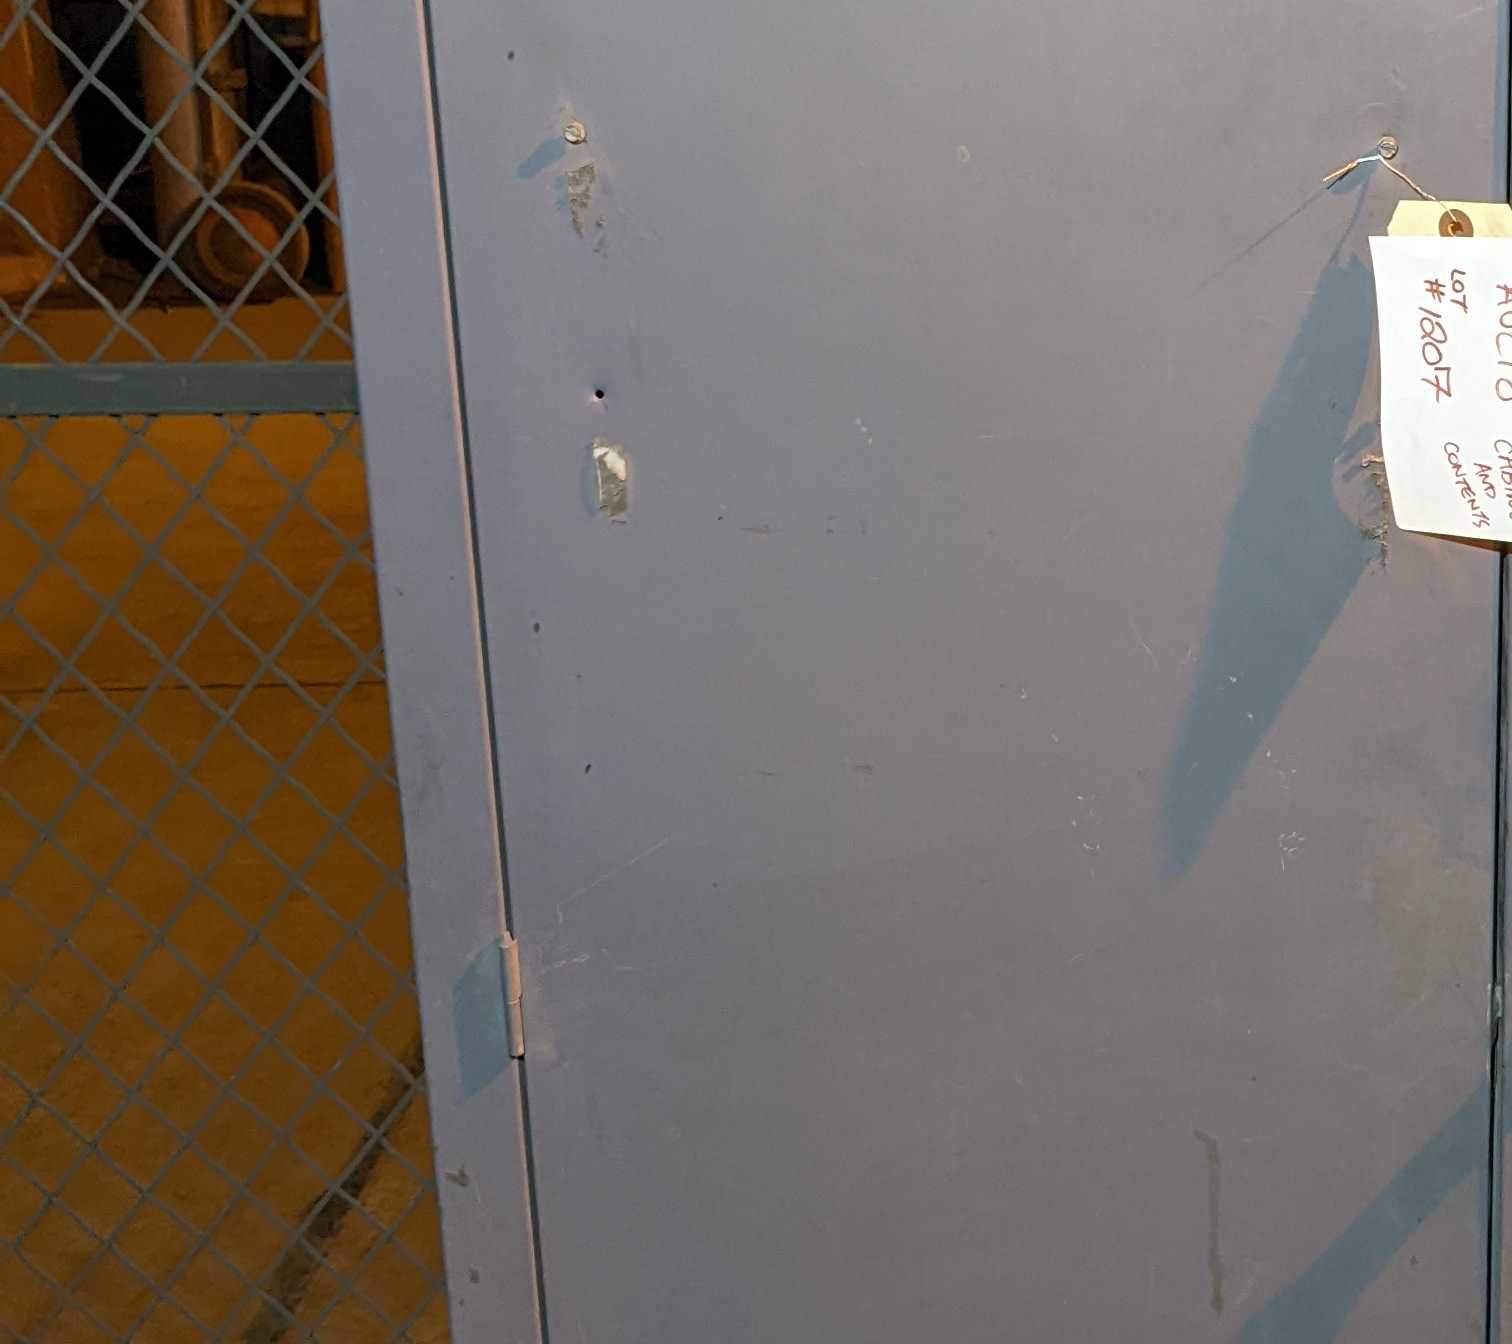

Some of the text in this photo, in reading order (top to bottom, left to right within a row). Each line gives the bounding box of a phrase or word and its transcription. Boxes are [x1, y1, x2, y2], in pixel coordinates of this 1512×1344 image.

[1449, 268, 1468, 314] LOT
[1443, 441, 1491, 528] CONTENTS
[1473, 462, 1496, 499] AND
